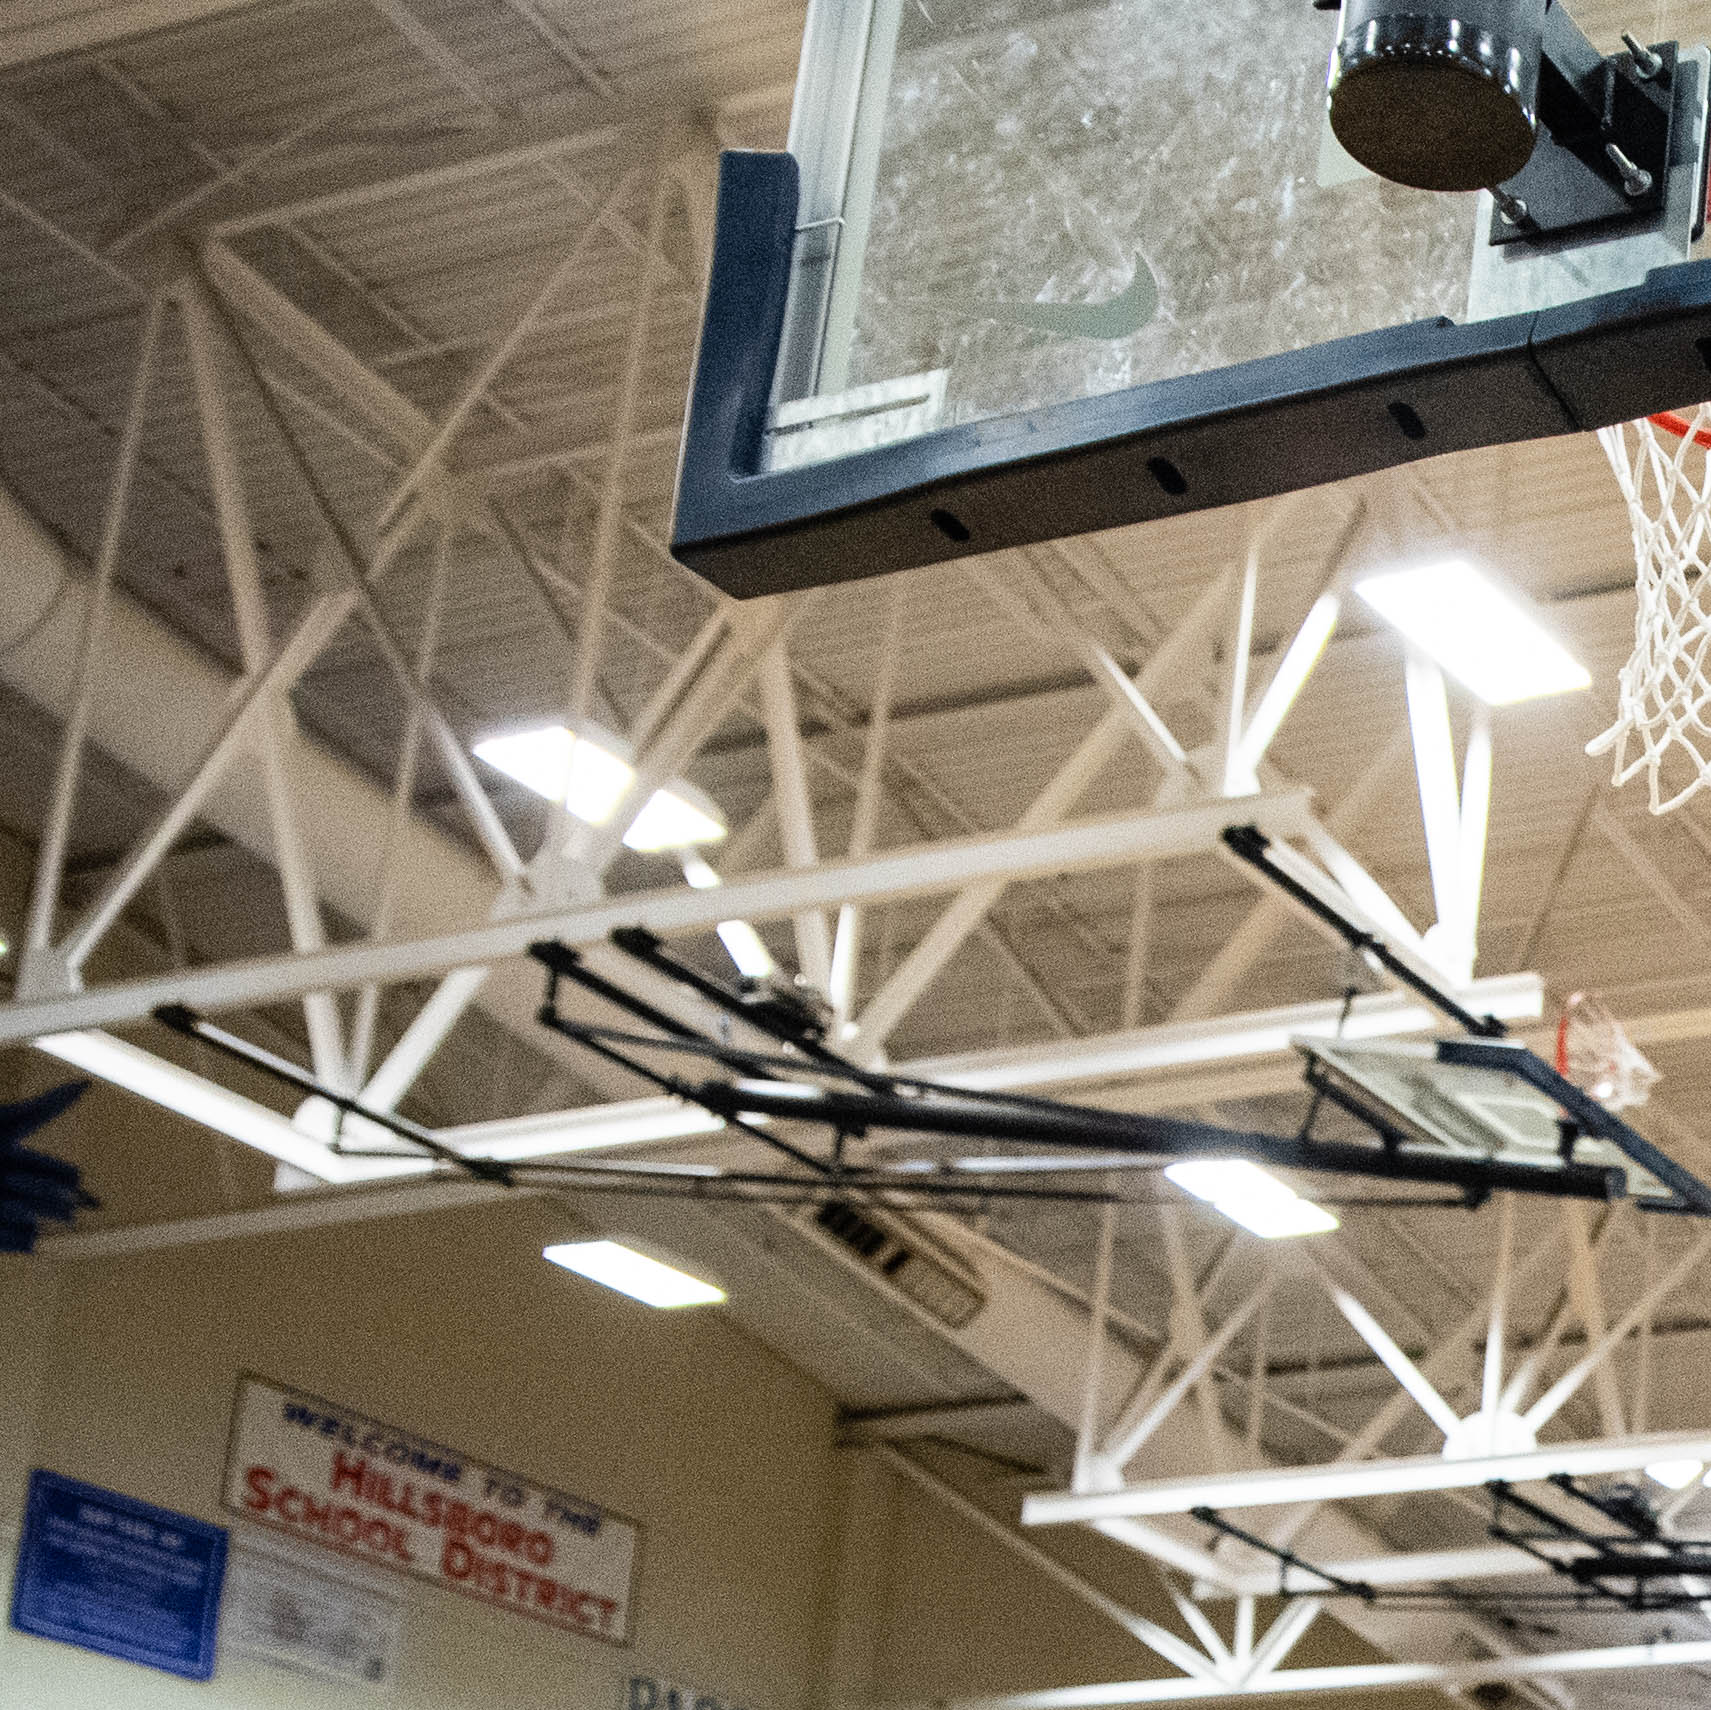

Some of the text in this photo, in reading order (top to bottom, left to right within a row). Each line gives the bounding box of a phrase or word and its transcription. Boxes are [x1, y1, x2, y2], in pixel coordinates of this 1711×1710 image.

[243, 1465, 411, 1563] SCHOOL
[442, 1538, 616, 1629] DISTRICT
[331, 1450, 555, 1567] HILLSBORO
